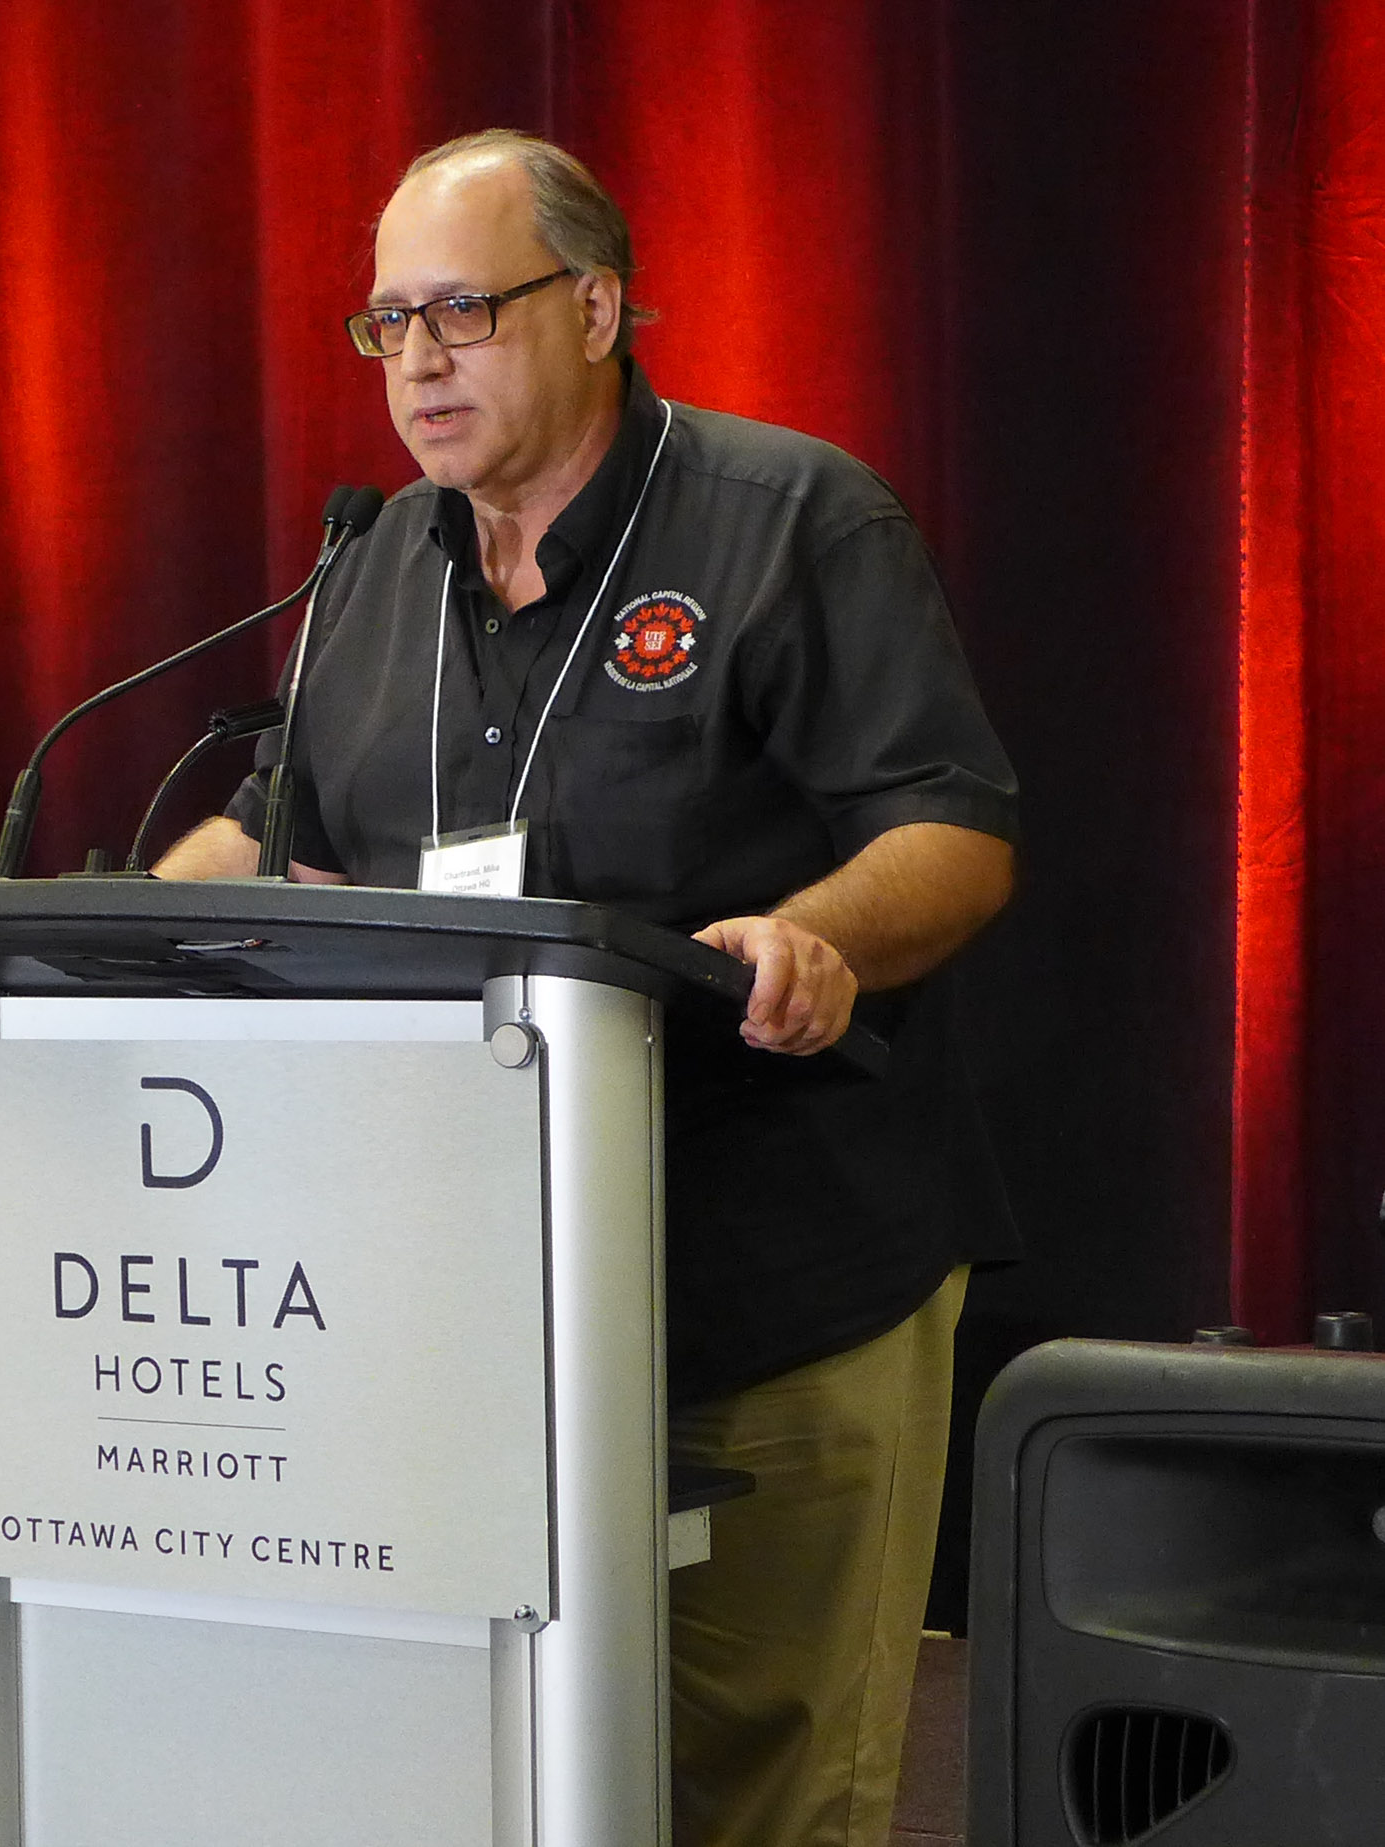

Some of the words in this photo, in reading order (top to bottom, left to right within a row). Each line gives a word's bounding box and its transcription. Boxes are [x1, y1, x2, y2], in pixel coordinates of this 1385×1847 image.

[614, 593, 651, 622] NATIONAL
[651, 590, 683, 601] CAPITAL
[682, 595, 707, 622] REGION
[626, 680, 636, 690] LA
[663, 661, 699, 689] NATIONALE
[54, 1252, 327, 1331] DELTA
[95, 1354, 286, 1402] HOTELS
[97, 1444, 288, 1482] MARRIOTT
[1, 1515, 139, 1551] OTTAWA
[155, 1528, 234, 1559] CITY
[251, 1535, 394, 1572] CENTRE
